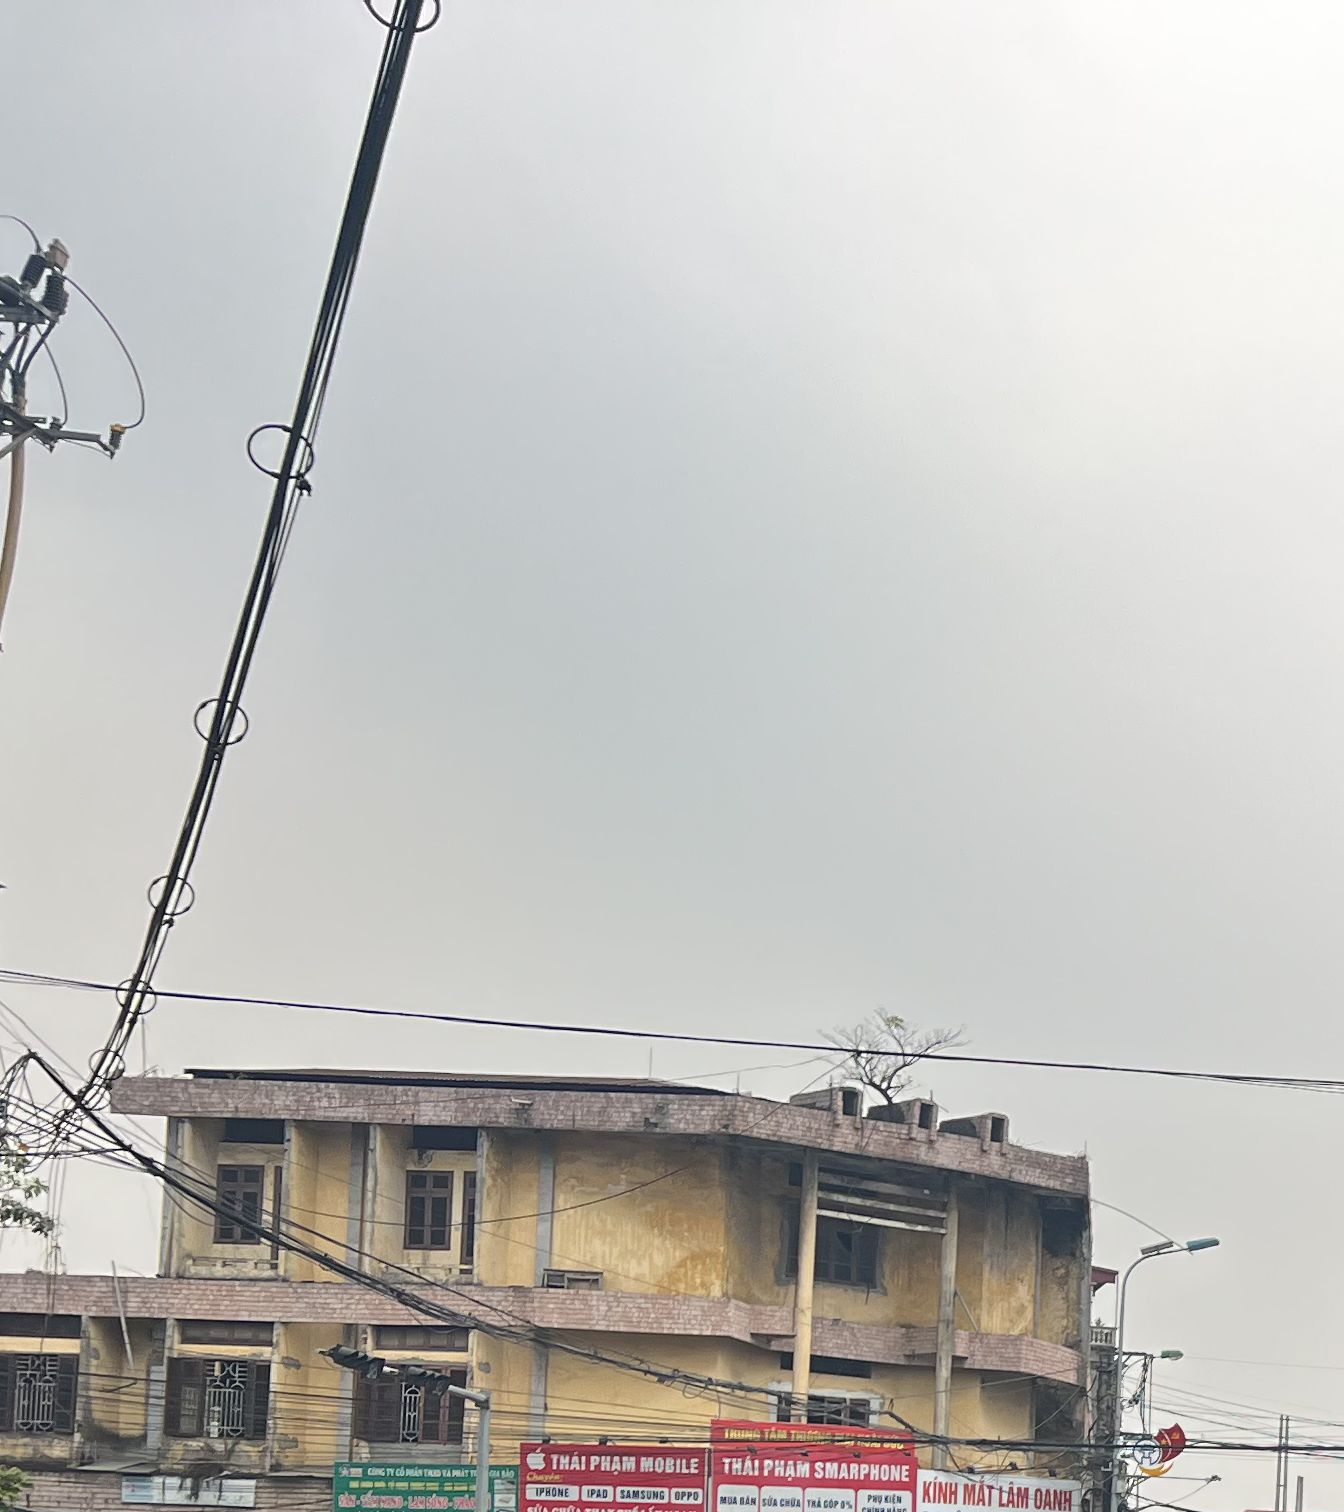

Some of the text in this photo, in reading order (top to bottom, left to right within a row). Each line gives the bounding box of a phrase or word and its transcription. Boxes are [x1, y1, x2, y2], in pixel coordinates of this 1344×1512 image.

[551, 1451, 700, 1475] THÁI PHẠM MOBILE
[722, 1455, 910, 1482] THÁI PHẠM SMARPHONE
[535, 1487, 698, 1501] IPHONE IPAD SAMSUNG OPPO
[720, 1496, 738, 1505] MUA
[739, 1495, 757, 1506] BÁN
[762, 1496, 777, 1507] SỬA
[780, 1496, 801, 1508] CHỮA
[867, 1494, 882, 1504] PHỤ
[922, 1475, 1072, 1512] KÍNH MẮT LÂM OANH
